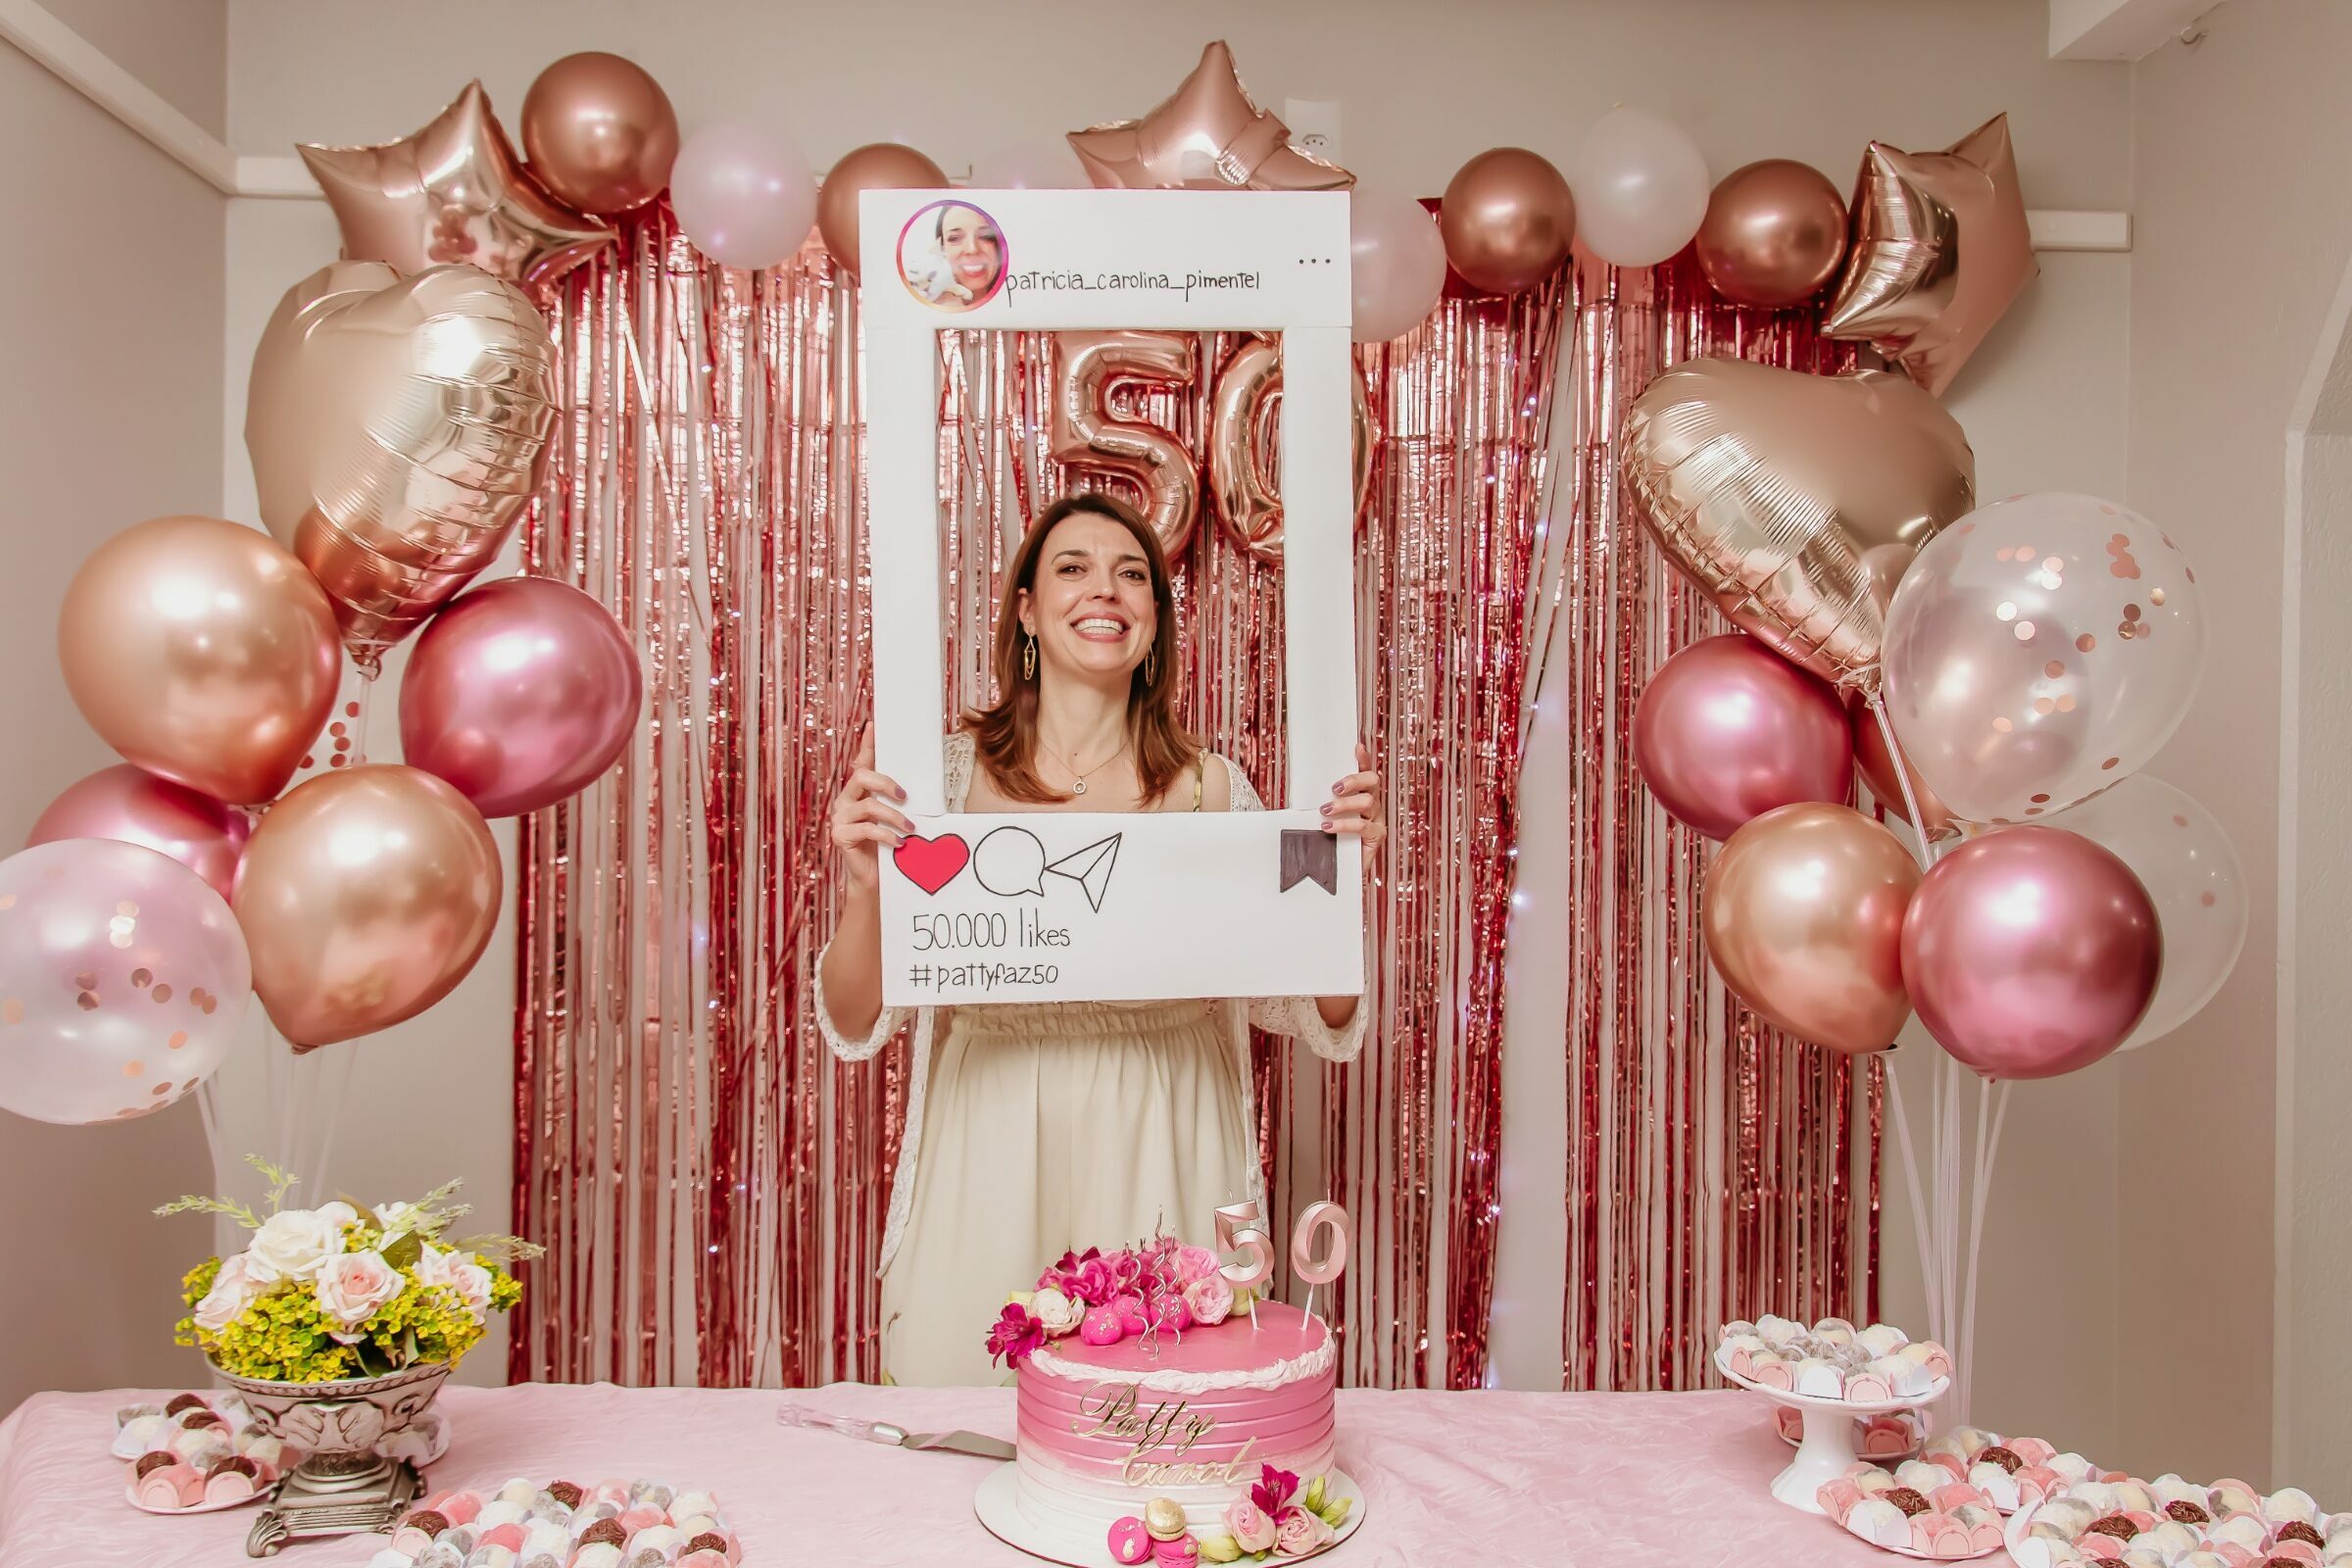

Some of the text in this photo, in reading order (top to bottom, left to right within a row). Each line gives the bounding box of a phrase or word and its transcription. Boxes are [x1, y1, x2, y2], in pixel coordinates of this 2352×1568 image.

[1005, 270, 1260, 308] patricia_carolina_pimentel
[911, 907, 1071, 951] 50.000 likes
[908, 963, 1058, 993] #pattyfaz50
[1071, 1380, 1218, 1457] Patty
[1113, 1433, 1257, 1487] Carol
